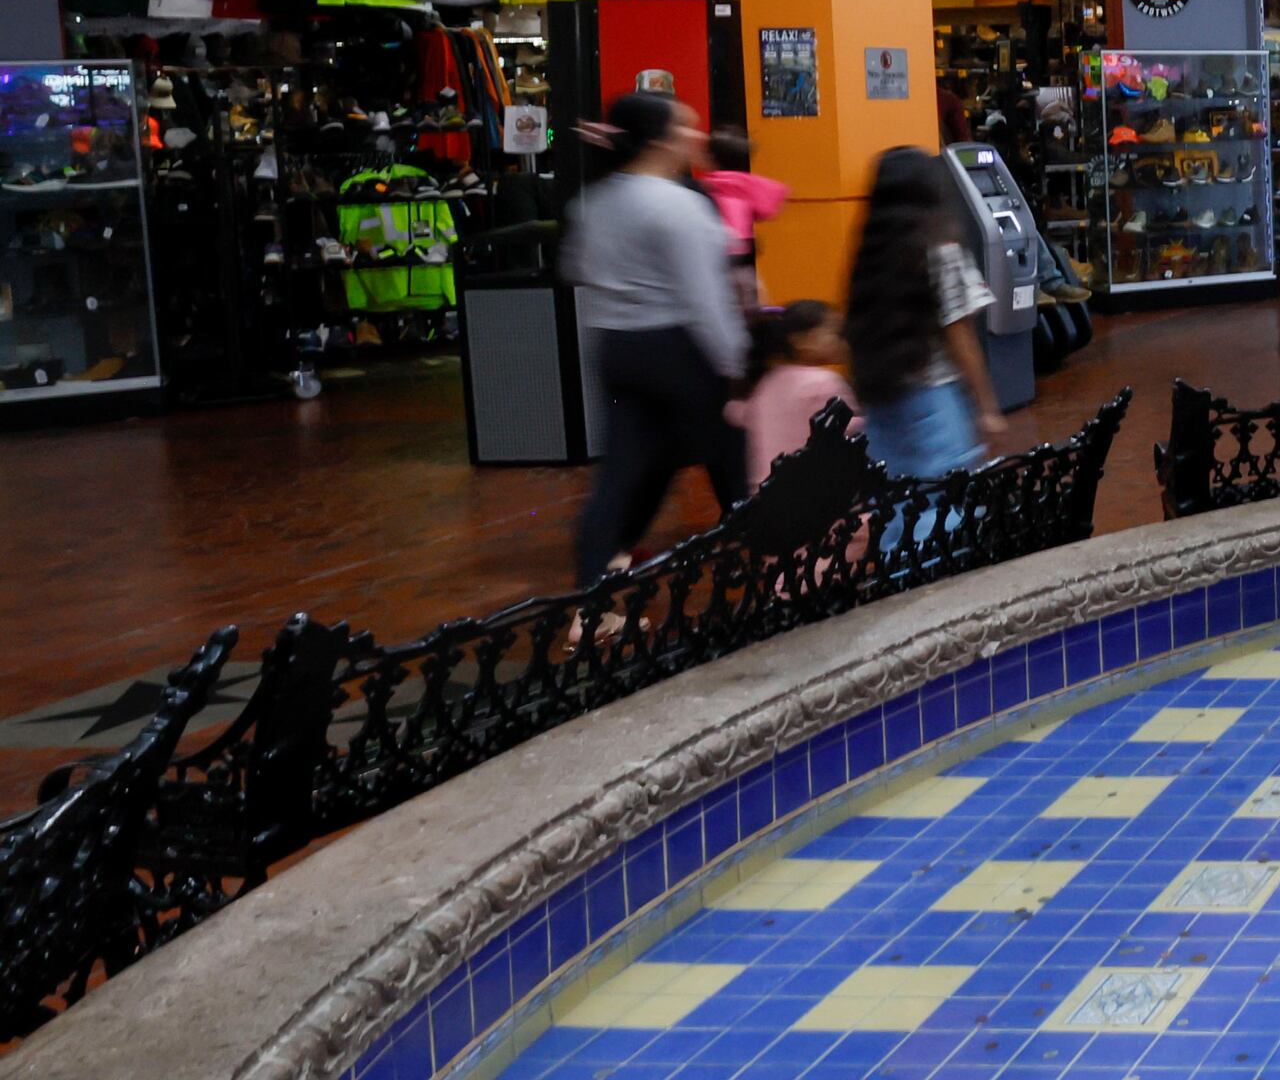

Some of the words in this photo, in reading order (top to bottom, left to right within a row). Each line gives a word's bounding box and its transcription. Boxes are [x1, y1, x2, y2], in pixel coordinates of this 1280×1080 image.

[1137, 0, 1185, 18] FOOTWEAR
[761, 29, 798, 41] RELAX!
[977, 150, 994, 164] ATM
